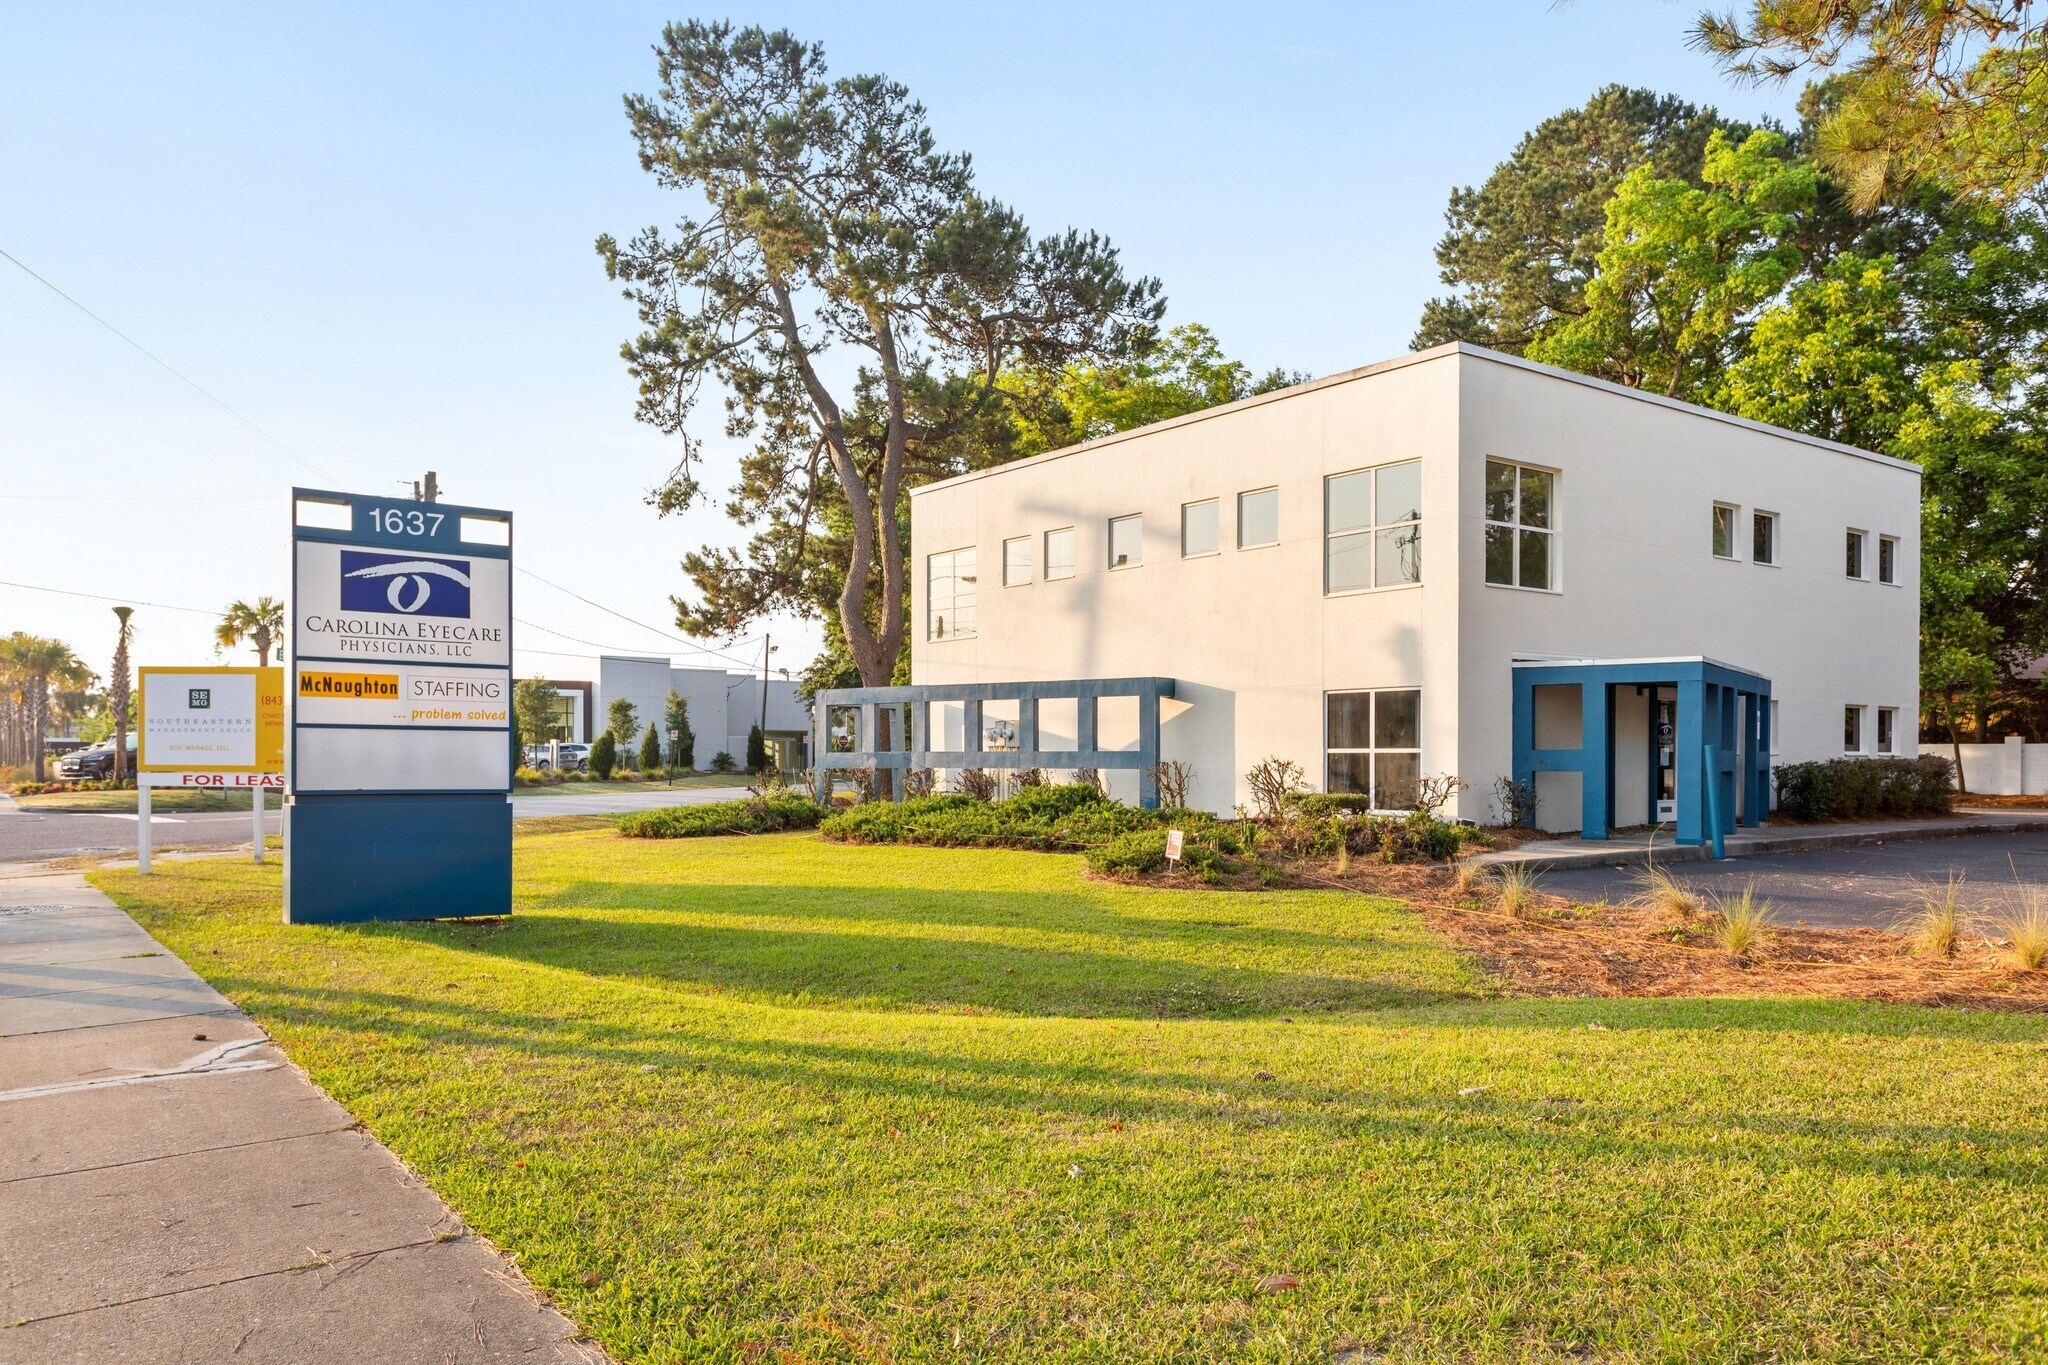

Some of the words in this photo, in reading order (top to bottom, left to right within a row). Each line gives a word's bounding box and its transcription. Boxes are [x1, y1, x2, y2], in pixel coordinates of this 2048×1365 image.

[369, 507, 445, 537] 1637
[306, 615, 408, 637] CAROLINA
[418, 622, 502, 642] EYECARE
[340, 639, 440, 656] PHYSICIANS,
[447, 645, 472, 657] LLC
[301, 675, 398, 696] McNaughton
[414, 680, 500, 698] STAFFING
[191, 691, 208, 700] SE
[261, 695, 283, 707] (843
[411, 708, 462, 721] problem
[467, 709, 506, 721] solved
[182, 774, 225, 786] FOR
[235, 774, 284, 786] LEAS
